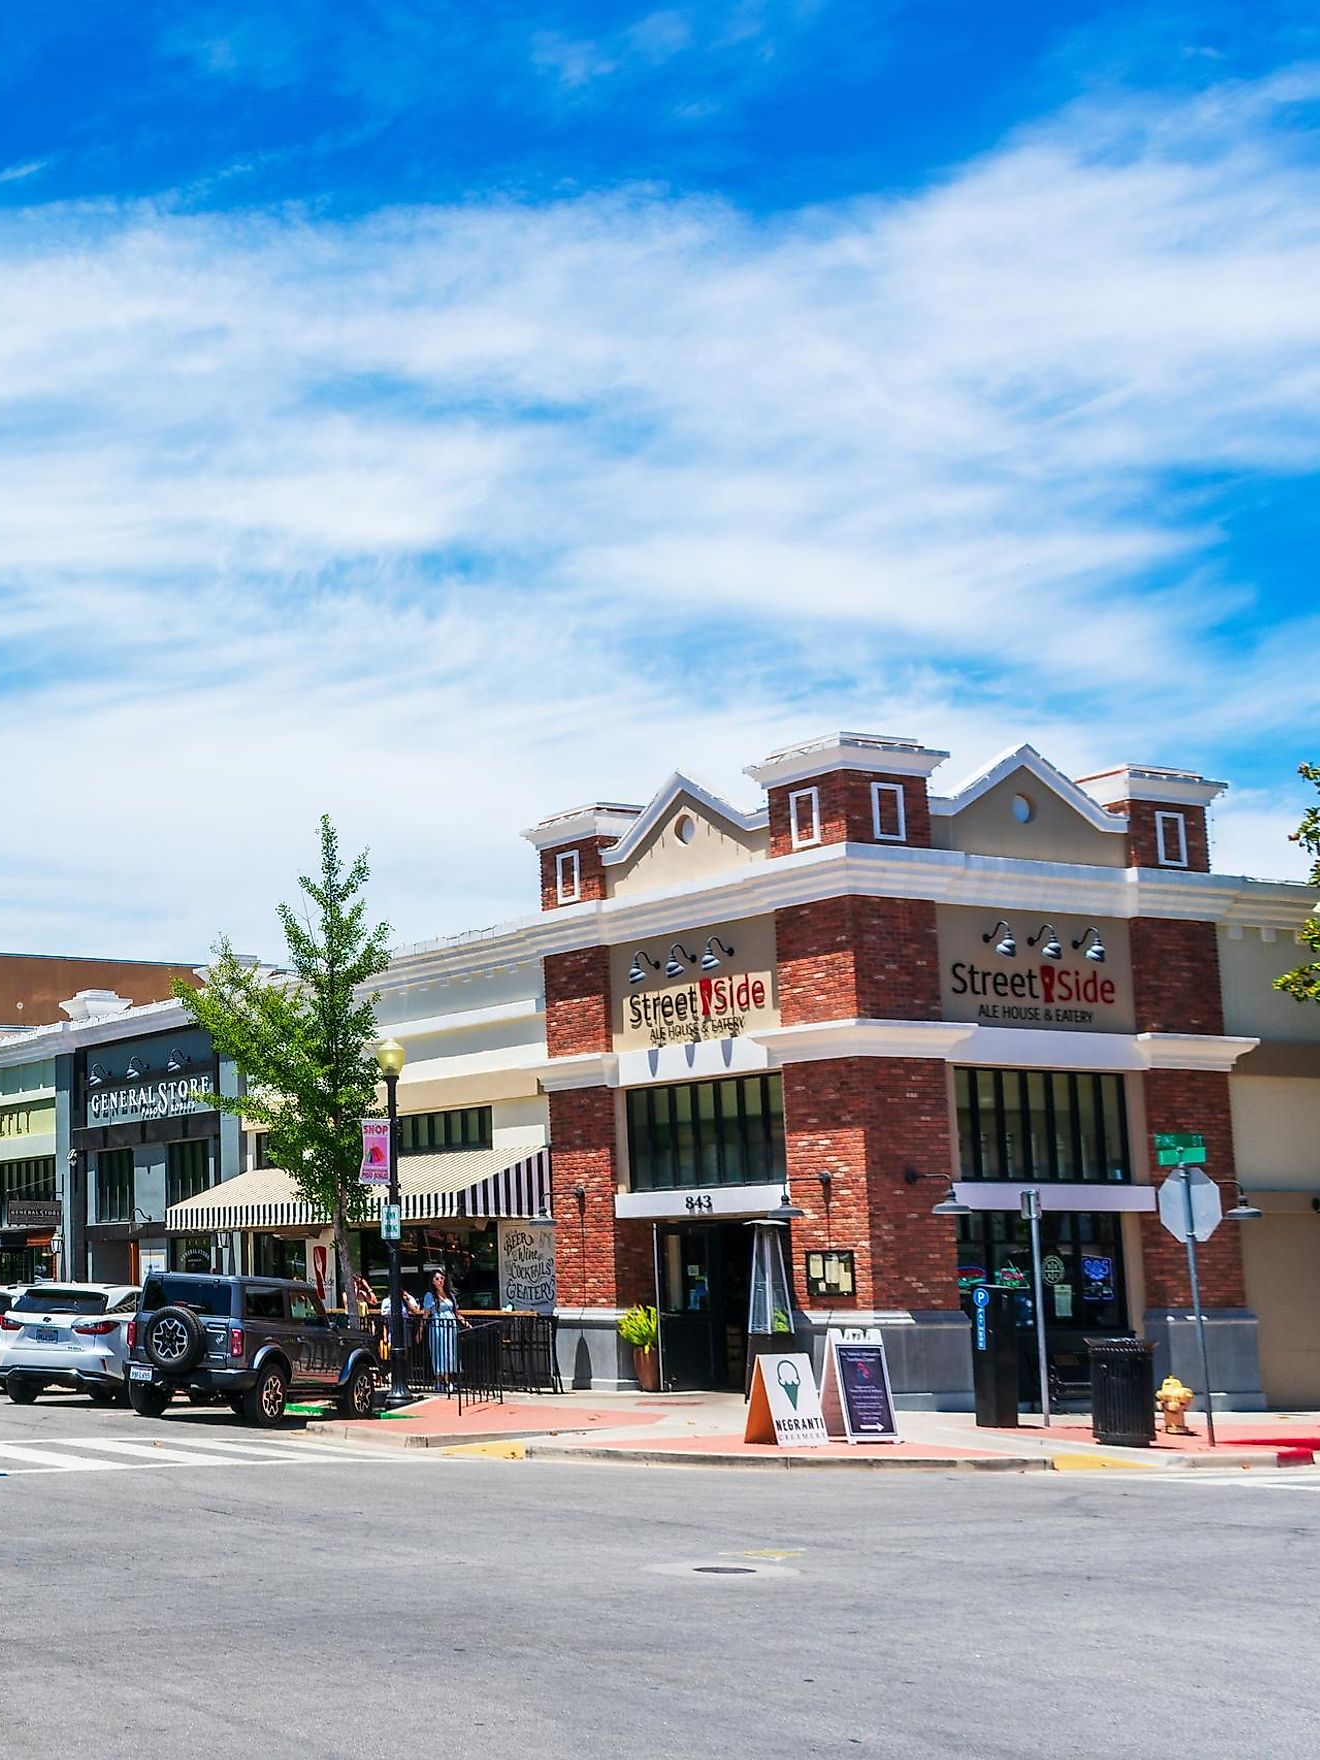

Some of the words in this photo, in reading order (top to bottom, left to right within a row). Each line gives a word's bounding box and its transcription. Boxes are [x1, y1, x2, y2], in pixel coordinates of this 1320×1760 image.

[952, 963, 1039, 999] Street
[1058, 970, 1116, 1004] Side
[629, 986, 697, 1025] Street
[714, 973, 765, 1010] Side
[979, 1004, 999, 1018] ALE
[1003, 1006, 1041, 1021] HOUSE
[1045, 1009, 1052, 1020] &
[1056, 1009, 1094, 1023] EATERY
[650, 1026, 666, 1041] ALE
[668, 1022, 698, 1038] HOUSE
[701, 1022, 709, 1033] &
[711, 1016, 746, 1032] EATERY
[91, 1086, 155, 1112] GENERAL
[158, 1076, 210, 1115] STORE
[363, 1124, 389, 1134] SHOP
[10, 1208, 39, 1216] GENERAL
[39, 1208, 61, 1218] STORE
[685, 1194, 713, 1210] 843
[504, 1230, 533, 1256] BEER
[509, 1258, 554, 1284] COCKTAILS
[516, 1276, 555, 1301] EATERY
[775, 1417, 825, 1431] NEGRANTI
